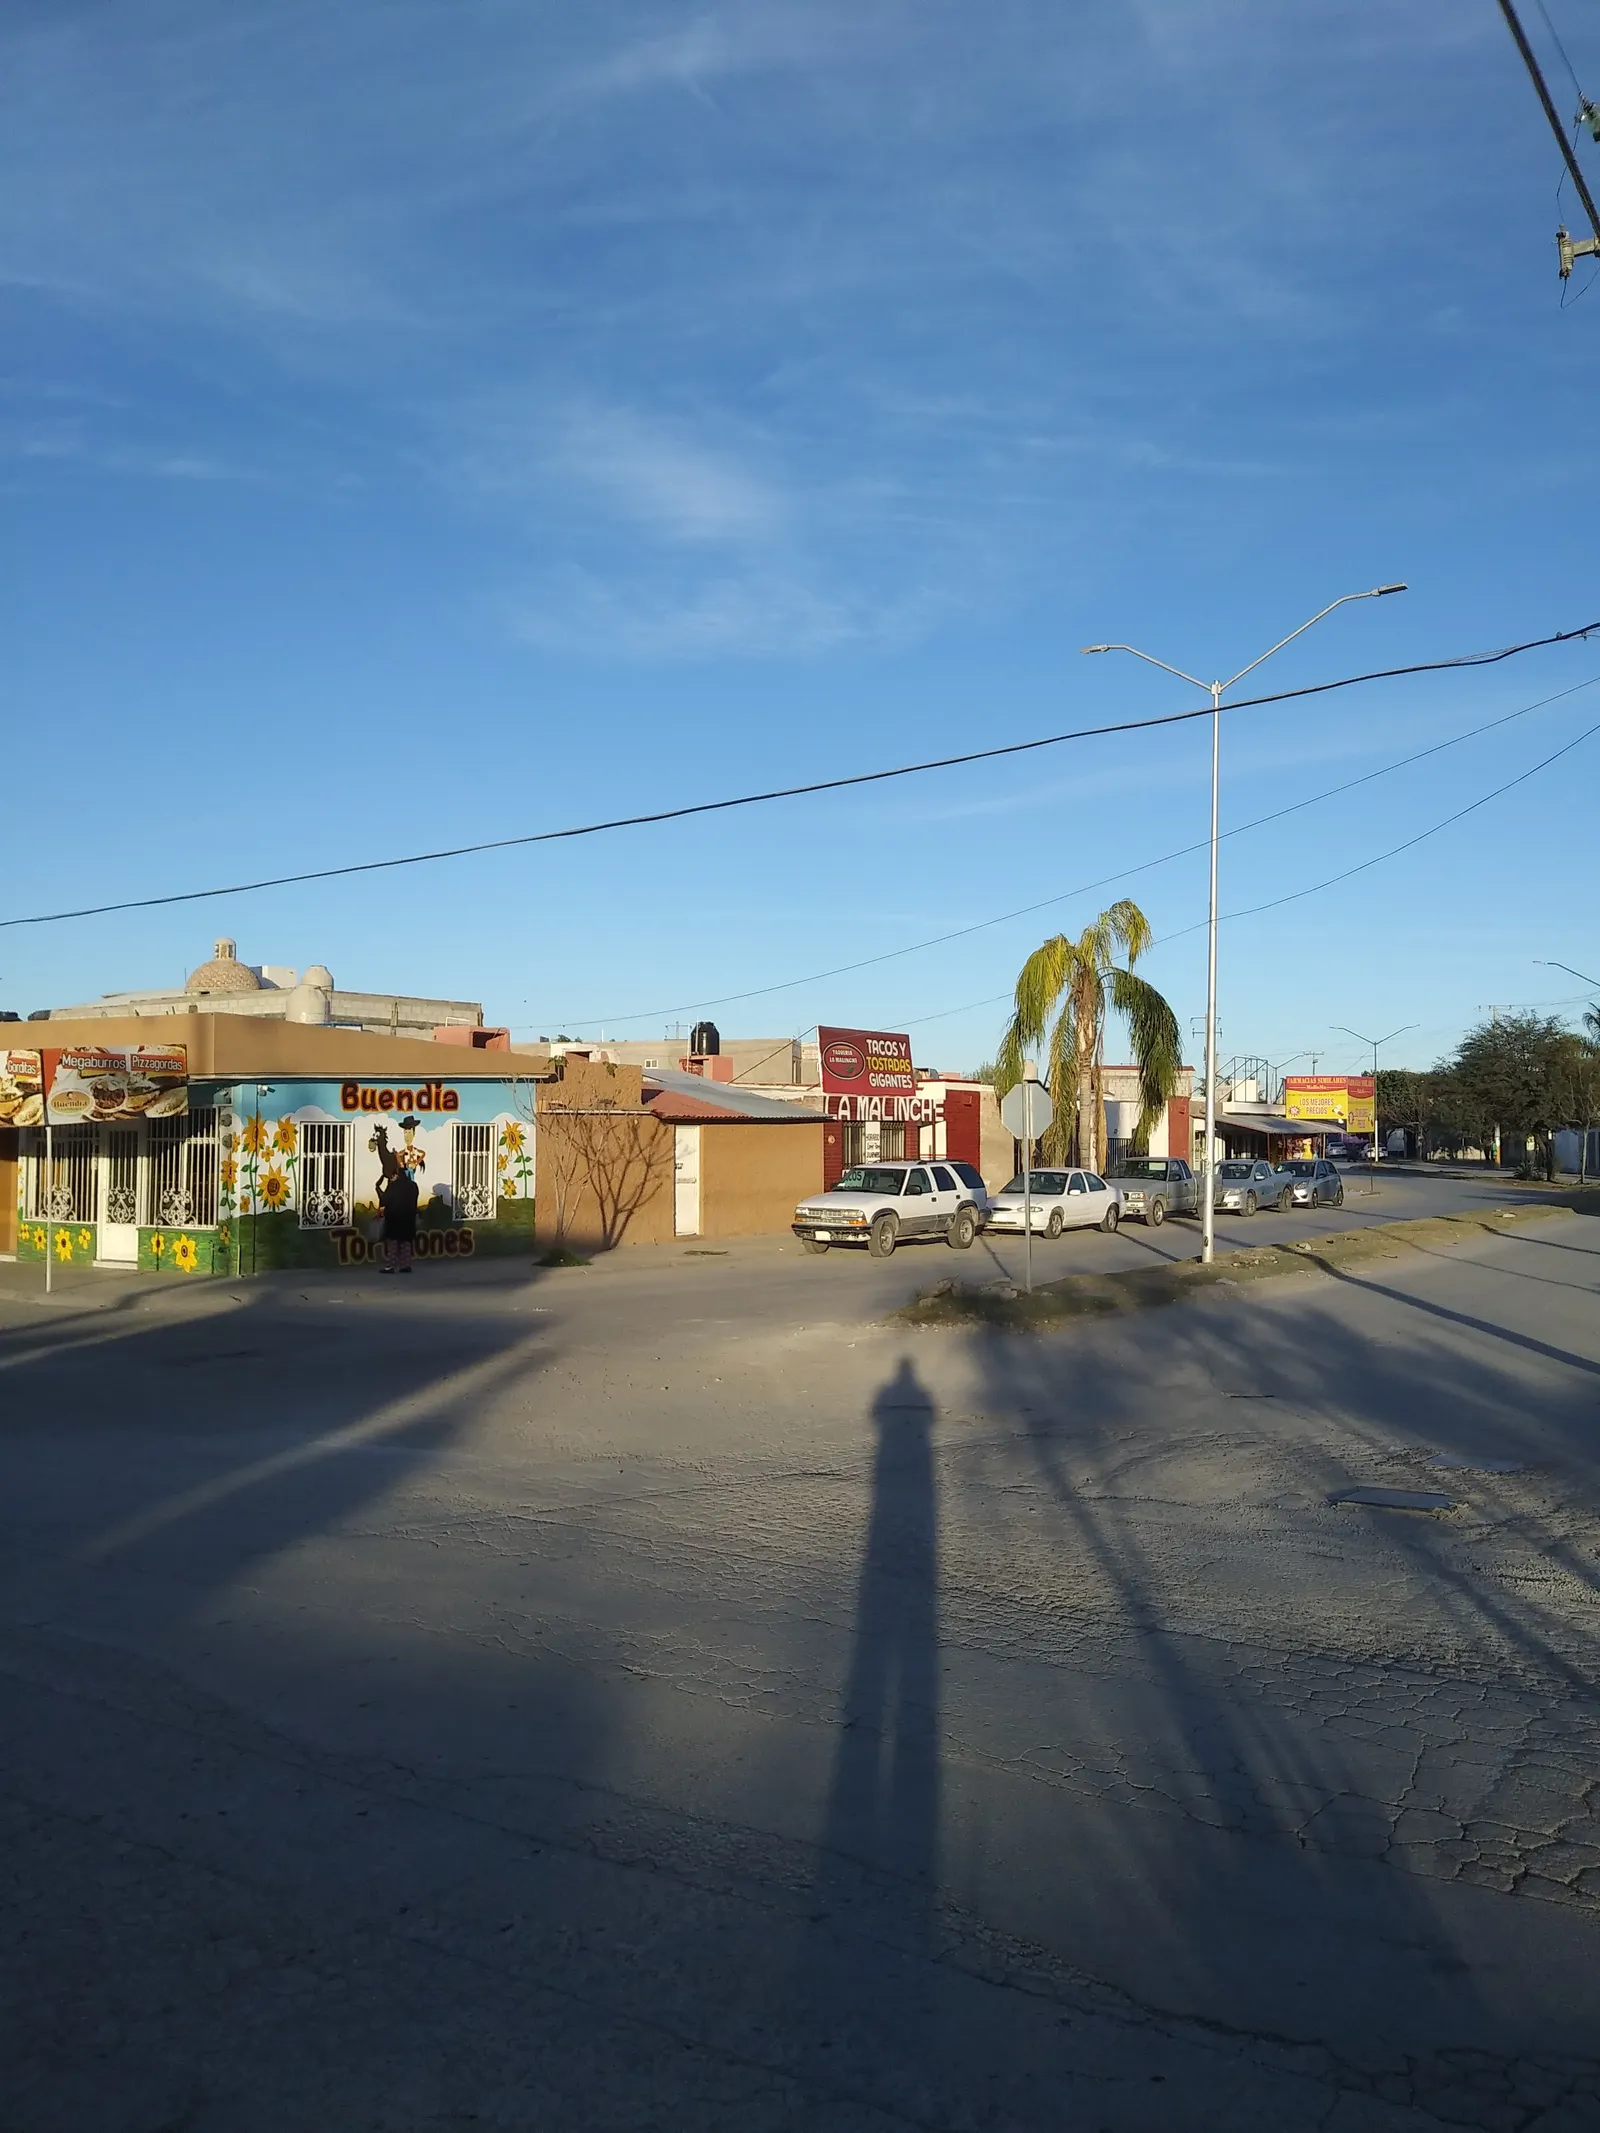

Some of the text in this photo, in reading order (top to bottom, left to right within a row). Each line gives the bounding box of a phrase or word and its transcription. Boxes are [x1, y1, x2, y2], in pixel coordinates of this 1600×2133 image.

[866, 1039, 906, 1057] TACOS Y
[7, 1060, 36, 1075] Gorditas
[61, 1053, 126, 1070] Megaburros
[132, 1055, 183, 1072] Pizzagordas
[866, 1056, 912, 1073] TOSTADAS
[869, 1073, 913, 1089] GIGANTES
[826, 1096, 945, 1122] LA MALINCHE
[1299, 1098, 1335, 1106] LOS MEJORES
[1305, 1106, 1328, 1115] PRECIOS
